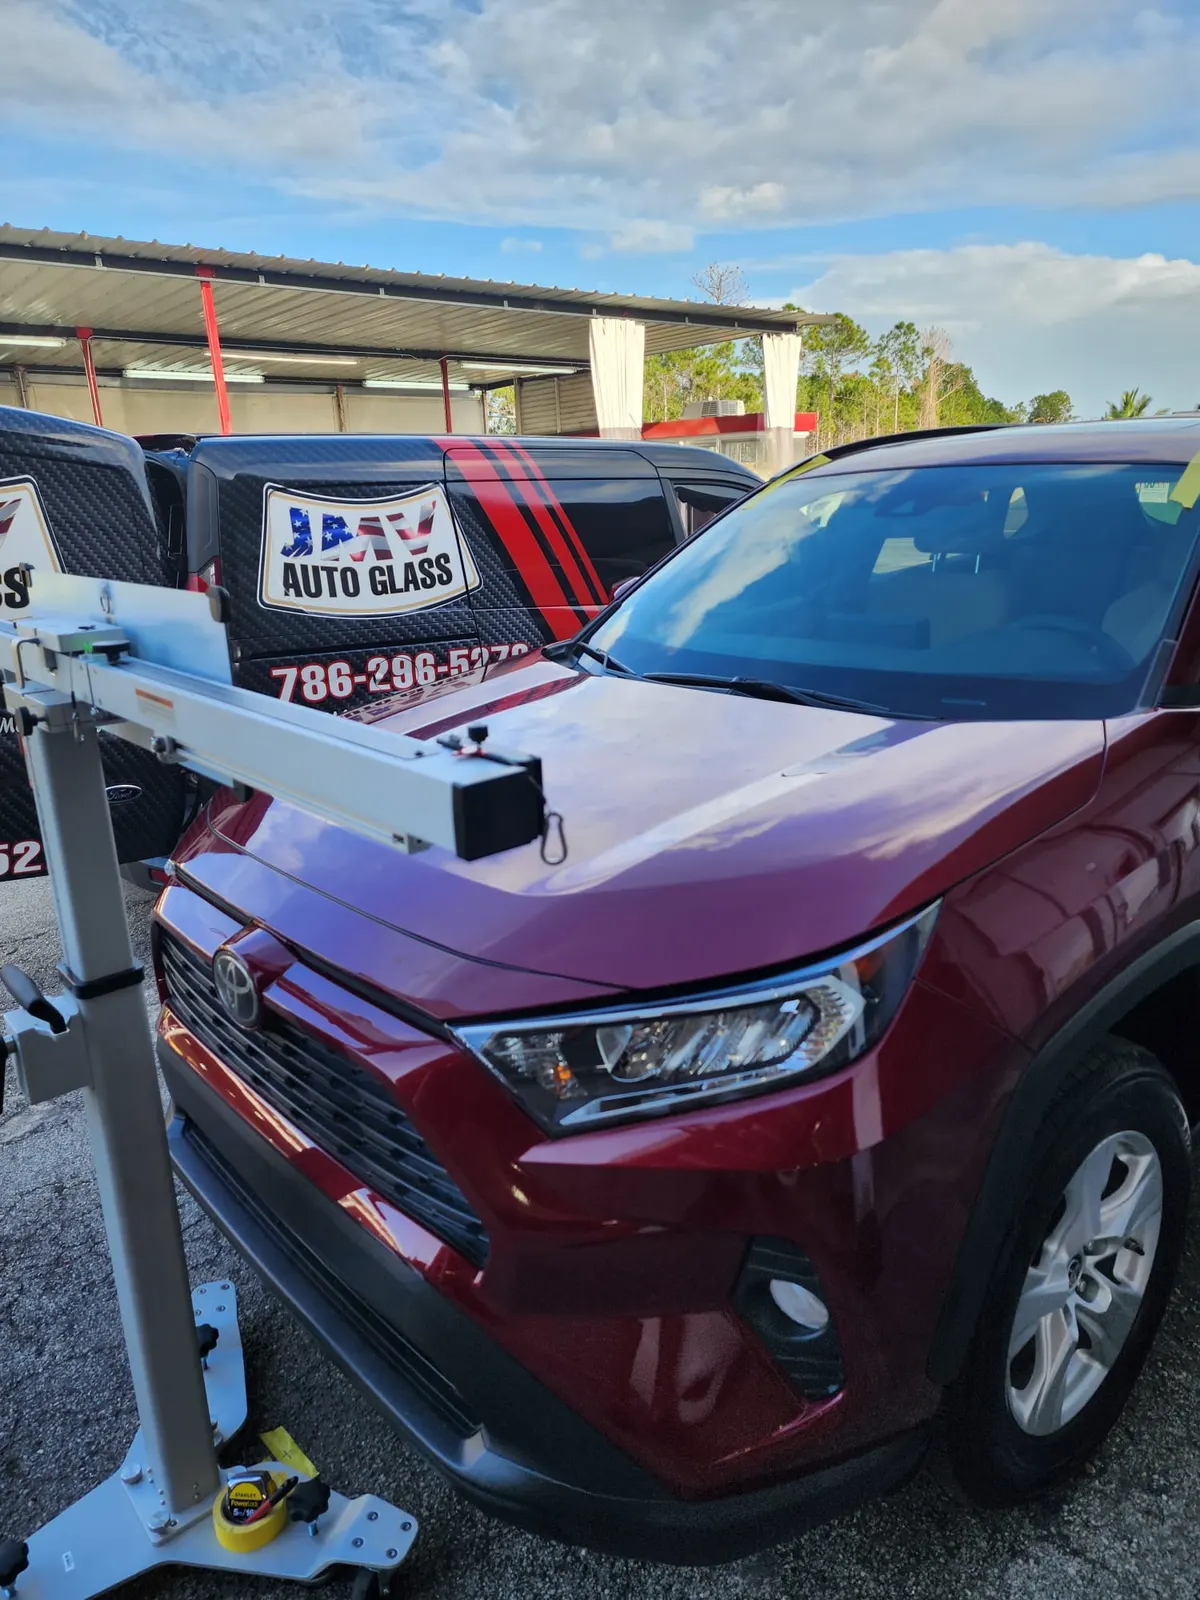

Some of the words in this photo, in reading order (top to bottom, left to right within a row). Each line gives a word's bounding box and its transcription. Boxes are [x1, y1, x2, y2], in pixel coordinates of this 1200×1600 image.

[280, 500, 437, 562] JMV
[283, 562, 361, 598] AUTO
[368, 552, 453, 596] GLASS
